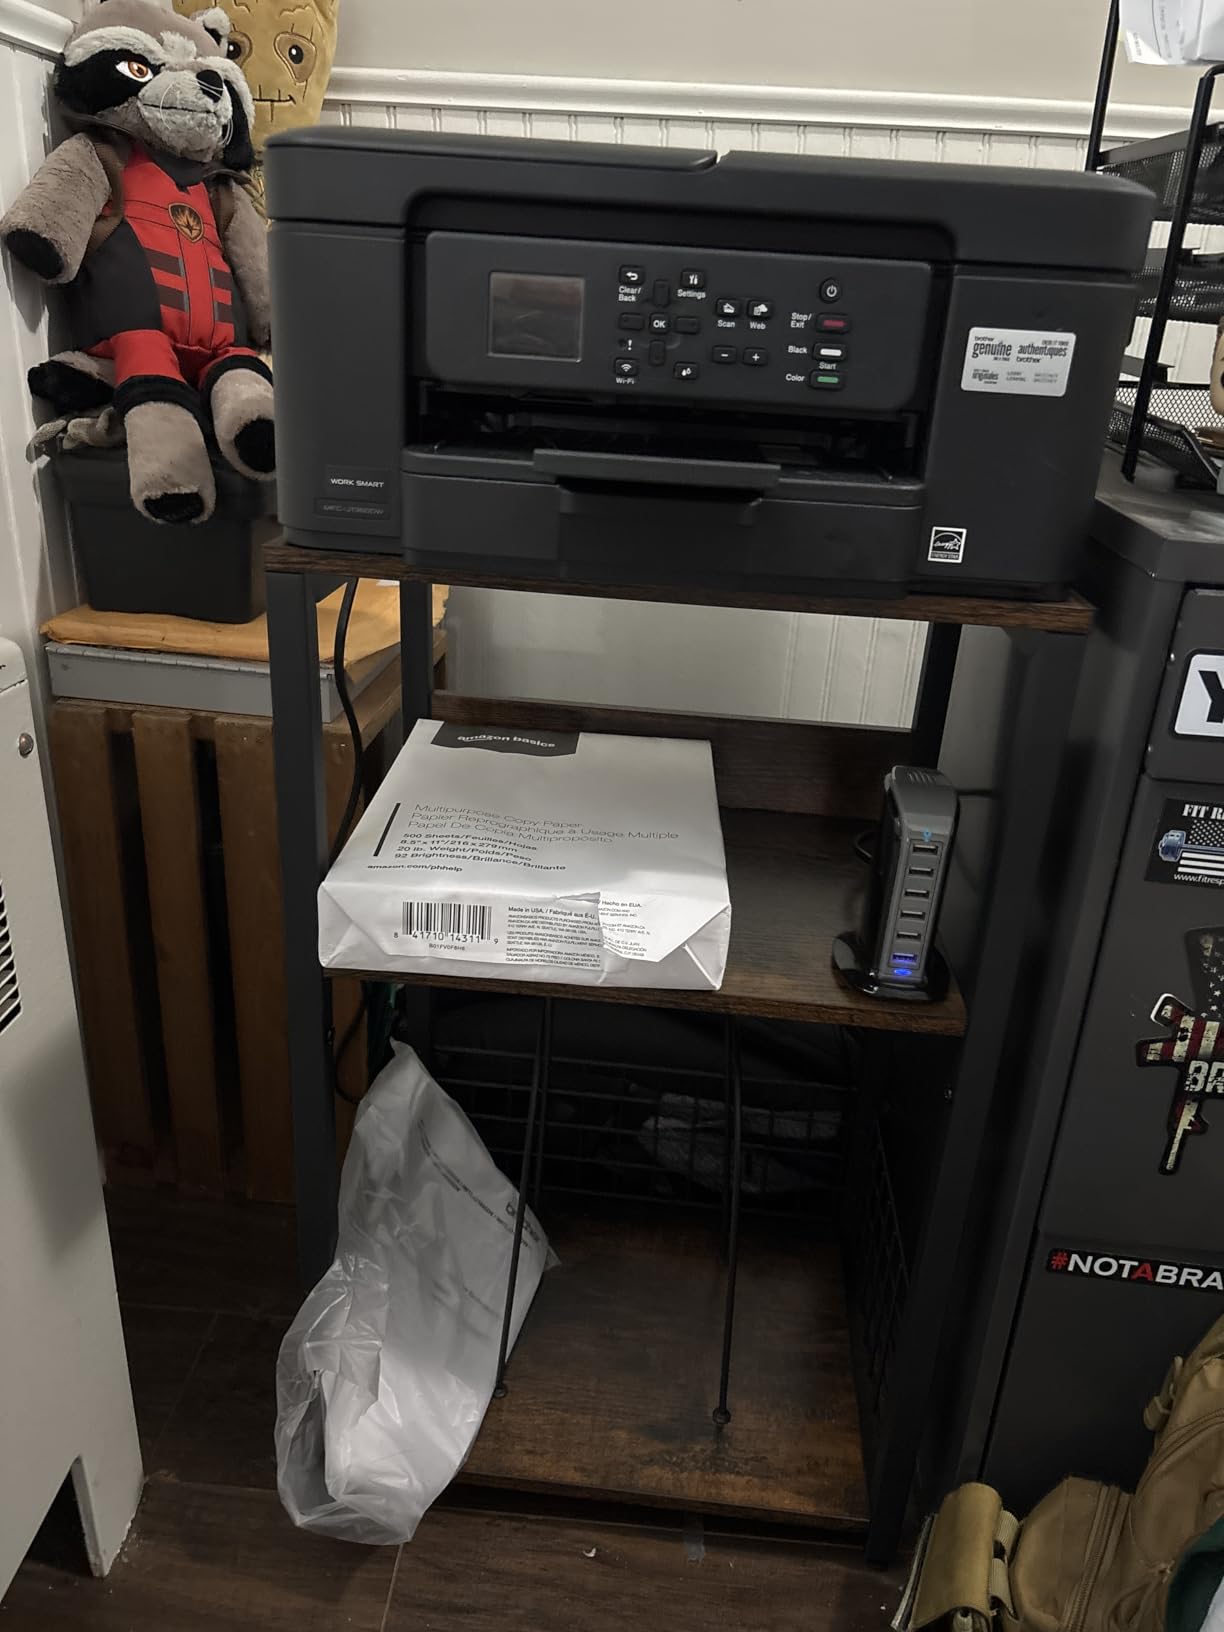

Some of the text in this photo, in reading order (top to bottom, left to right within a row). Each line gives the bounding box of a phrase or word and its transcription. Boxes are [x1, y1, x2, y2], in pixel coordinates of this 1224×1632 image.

[618, 286, 641, 294] Clear/
[677, 289, 706, 299] Settings
[618, 294, 636, 302] Back
[791, 312, 812, 321] Stop/
[653, 320, 666, 328] OK
[717, 320, 736, 328] Scan
[750, 322, 766, 330] Web
[790, 321, 805, 329] Exit
[787, 345, 808, 354] Black
[971, 341, 1012, 358] genuine
[1016, 355, 1041, 363] brother
[819, 362, 837, 370] Start
[615, 377, 635, 385] Wi-Fi
[785, 374, 805, 382] Color
[330, 478, 384, 488] WORK SMART
[457, 734, 555, 747] amazon basics
[1182, 804, 1209, 818] FIT
[415, 804, 584, 829] Multipurpose Copy Paper
[408, 820, 447, 829] Papel
[451, 821, 471, 829] De
[474, 824, 514, 837] Copia
[412, 812, 453, 821] Papier
[458, 815, 564, 835] Reprographique
[580, 829, 624, 839] Usage
[628, 831, 680, 841] Multiple
[425, 833, 537, 850] Sheets/Feuilles/Hojas
[429, 846, 532, 861] Weight/Poids/Peso
[410, 853, 567, 871] Brightness/Brillance/Brillante
[367, 864, 463, 872] amazon.com/phhelp
[412, 931, 445, 941] 41710
[449, 933, 480, 944] 14311
[1051, 1252, 1224, 1291] #NOTABRA
